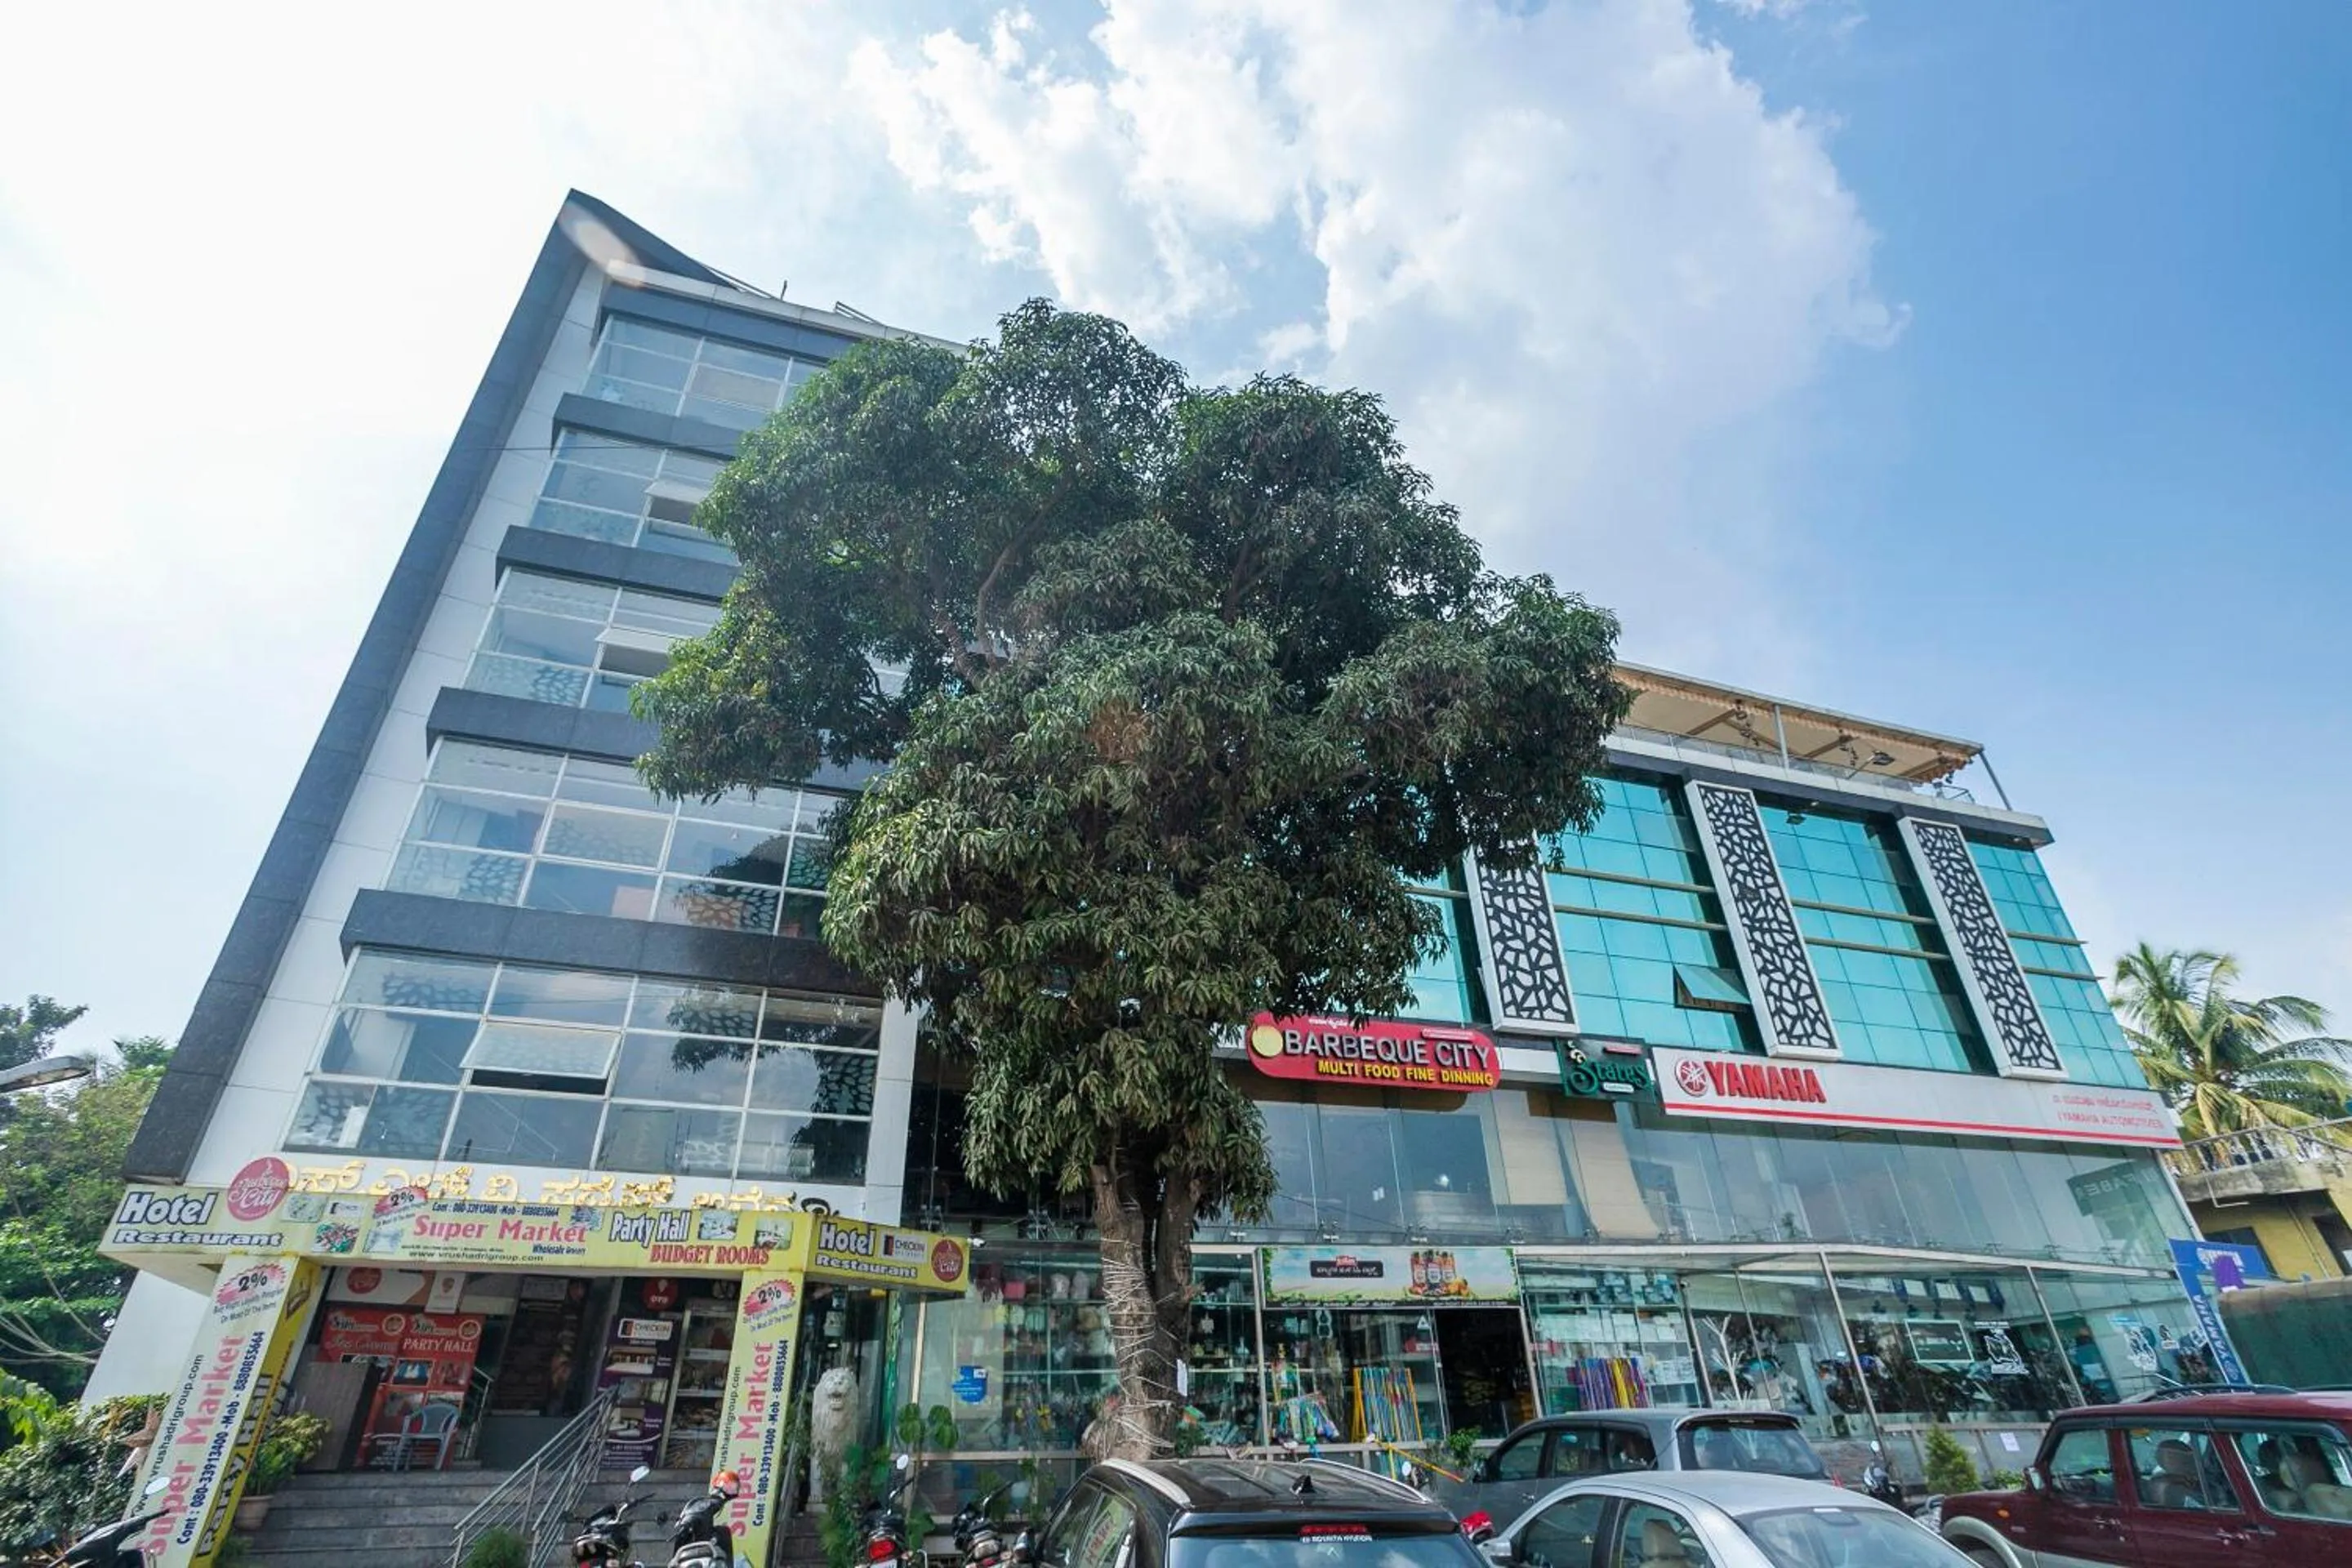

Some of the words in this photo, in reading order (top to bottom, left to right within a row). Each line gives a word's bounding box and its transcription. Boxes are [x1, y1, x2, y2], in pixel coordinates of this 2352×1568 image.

[1285, 1030, 1430, 1065] BARBEQUE
[1436, 1041, 1490, 1069] CITY
[1316, 1060, 1359, 1076] MULTI
[1365, 1065, 1401, 1080] FOOD
[1405, 1067, 1436, 1082] FINE
[1441, 1070, 1494, 1086] DINNING
[1704, 1060, 1827, 1104] YAMAHA
[117, 1191, 219, 1225] Hotel
[390, 1190, 415, 1207] 2%
[113, 1228, 285, 1246] Restaurant
[413, 1214, 488, 1241] Super
[498, 1218, 587, 1242] Market
[608, 1210, 655, 1249] Party
[654, 1210, 693, 1242] Hall
[818, 1221, 877, 1256] Hotel
[649, 1244, 713, 1263] BUDGET
[715, 1245, 770, 1265] ROOMS
[815, 1253, 918, 1278] Restaurant
[238, 1271, 268, 1292] 2%
[758, 1286, 782, 1304] 2%
[403, 1338, 443, 1351] PARTY
[443, 1341, 473, 1352] HALL
[2194, 1294, 2231, 1364] YAMAHA
[736, 1342, 773, 1441] Market
[235, 1374, 274, 1446] Hall
[136, 1460, 197, 1556] Super
[177, 1335, 246, 1446] Market
[176, 1517, 198, 1544] Cont
[189, 1432, 229, 1508] 080-33913400
[728, 1453, 756, 1537] Super
